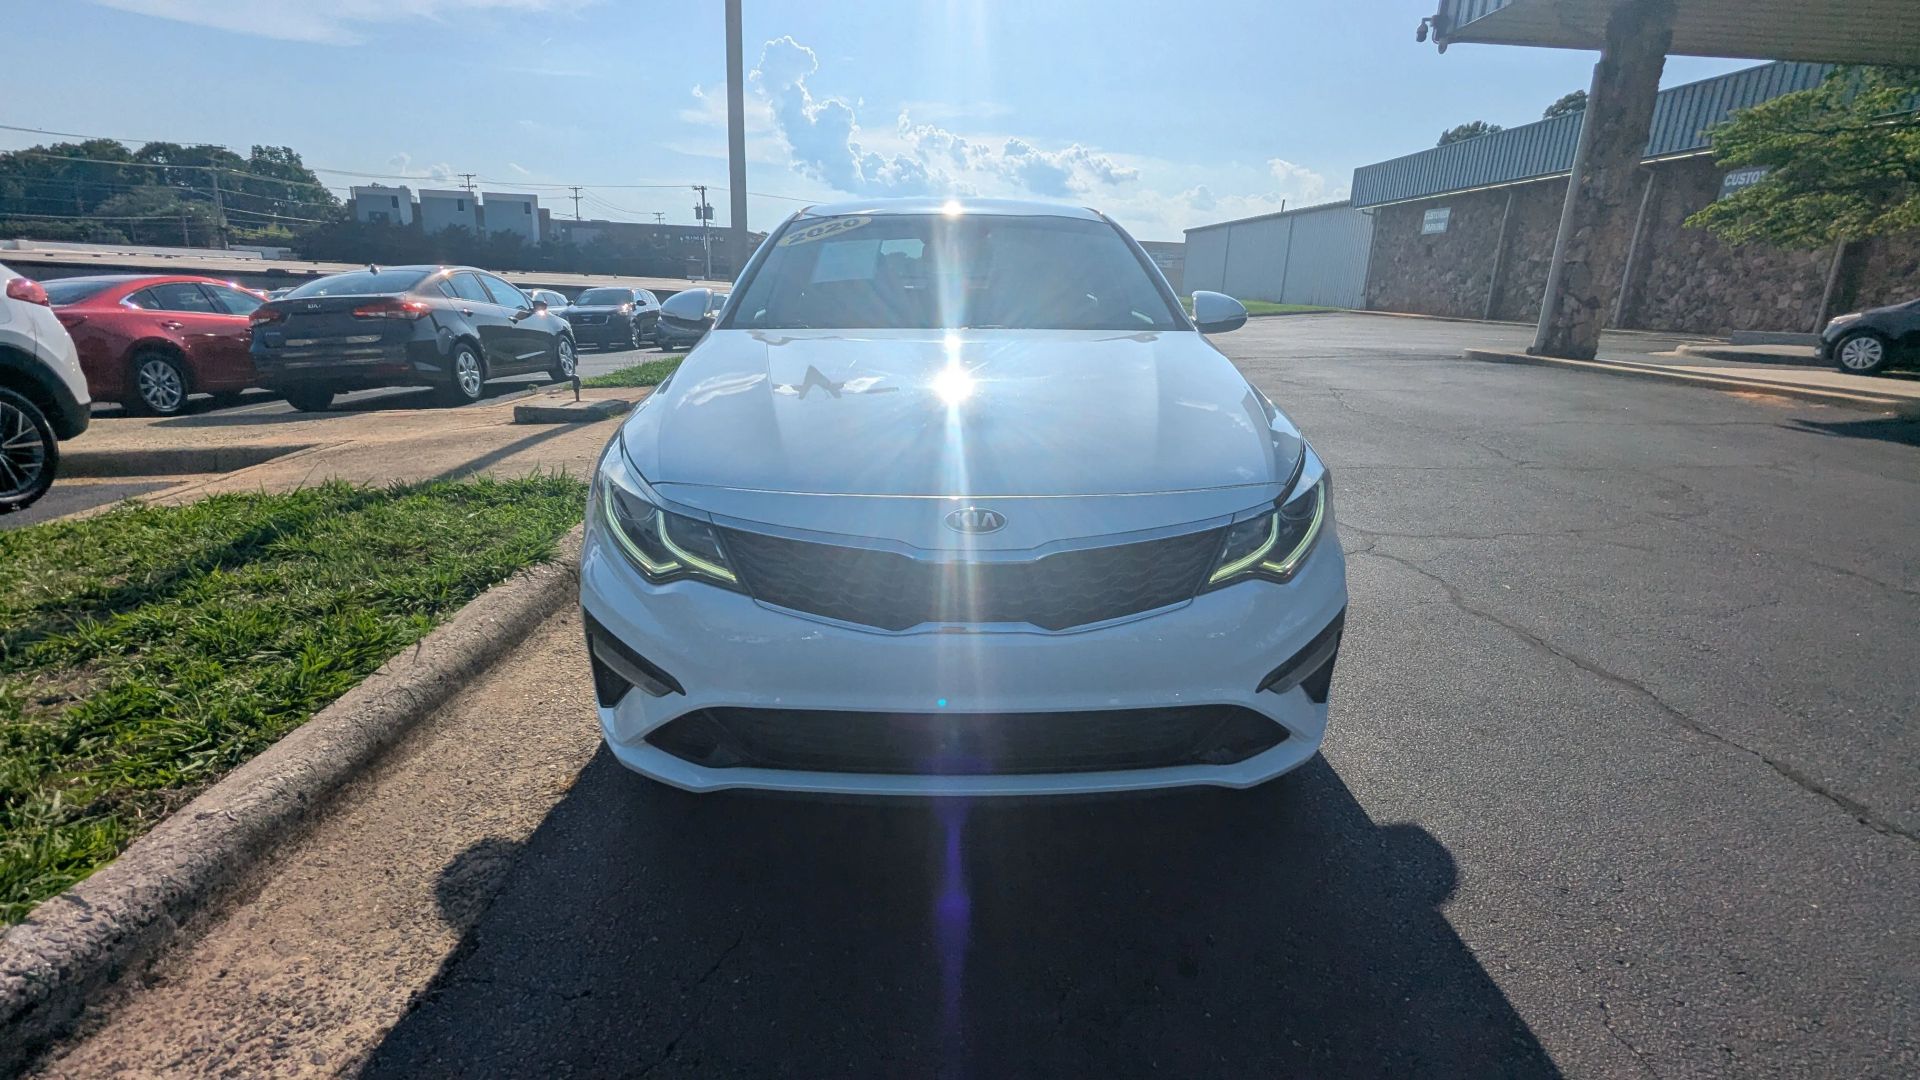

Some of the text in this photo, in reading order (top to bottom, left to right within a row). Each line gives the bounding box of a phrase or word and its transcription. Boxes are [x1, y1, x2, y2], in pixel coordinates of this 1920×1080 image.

[1724, 170, 1768, 187] CUSTO
[788, 218, 860, 245] 2020
[953, 511, 998, 528] KIA
